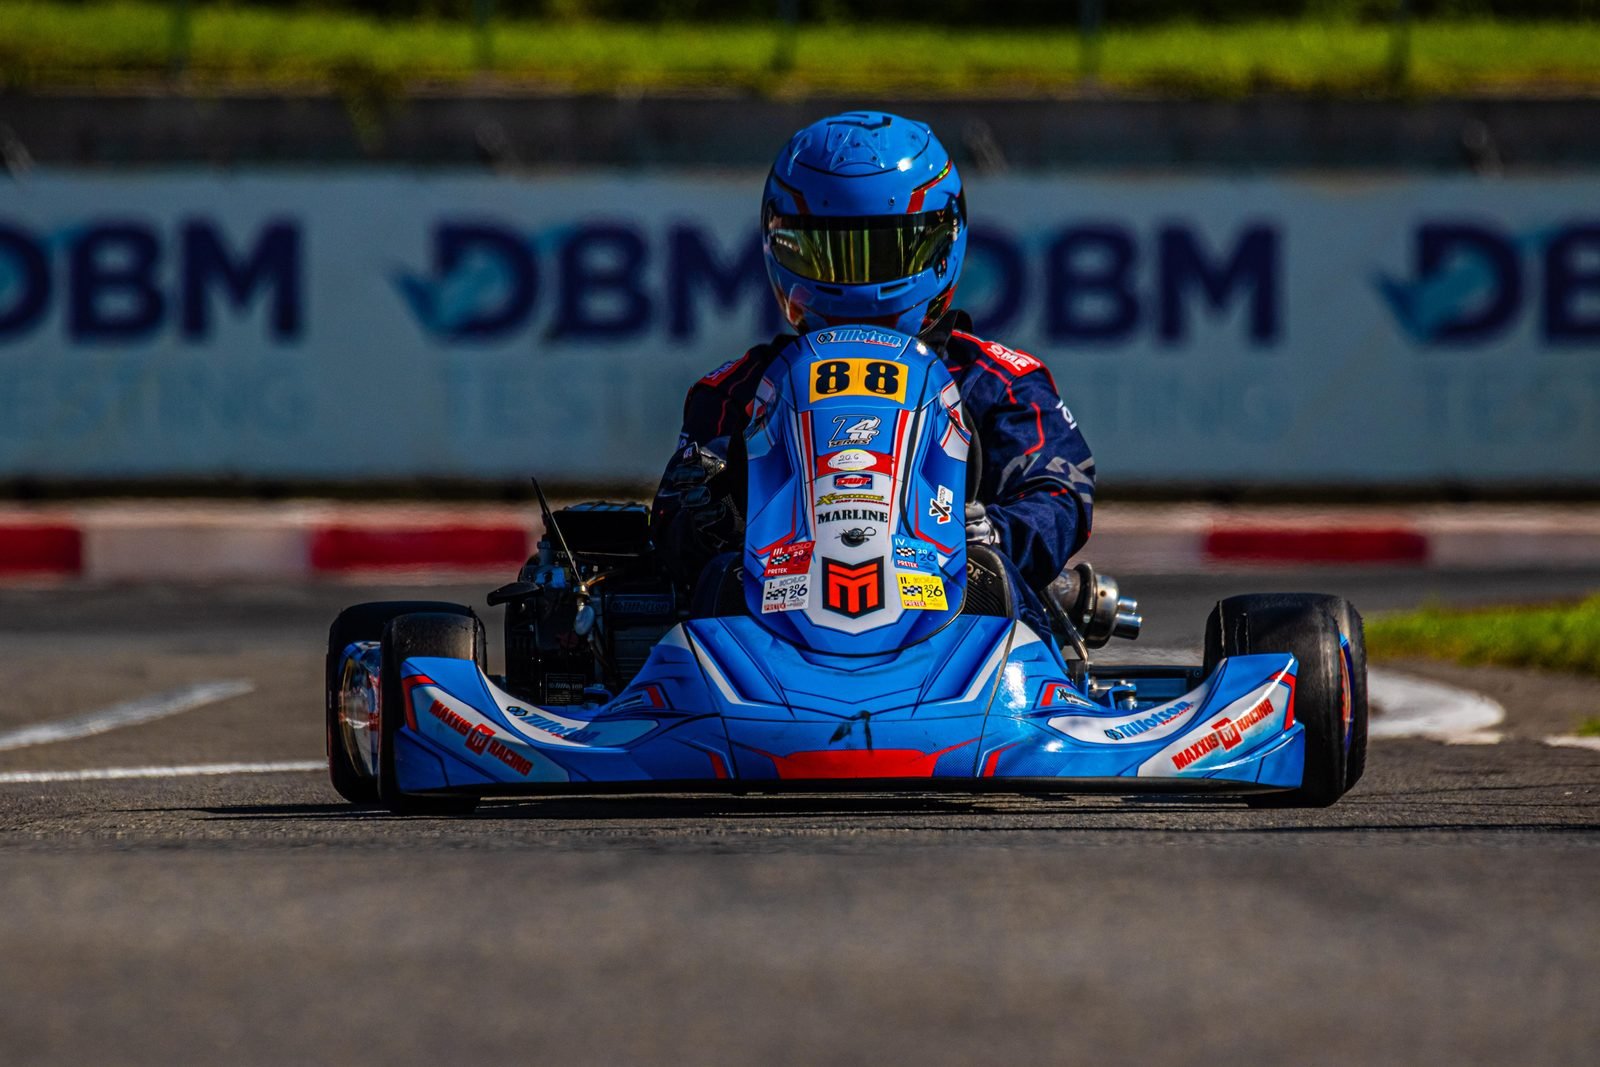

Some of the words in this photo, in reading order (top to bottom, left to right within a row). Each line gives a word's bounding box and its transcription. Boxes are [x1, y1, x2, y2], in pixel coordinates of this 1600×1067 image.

[832, 329, 900, 345] Tillotson
[990, 344, 1030, 369] OMP
[816, 509, 888, 524] MARLINE
[1115, 701, 1191, 737] Tillotson
[1171, 732, 1220, 770] MAXXIS
[1236, 698, 1274, 732] RACING
[429, 699, 473, 736] MAXXIS
[487, 739, 534, 777] RACING
